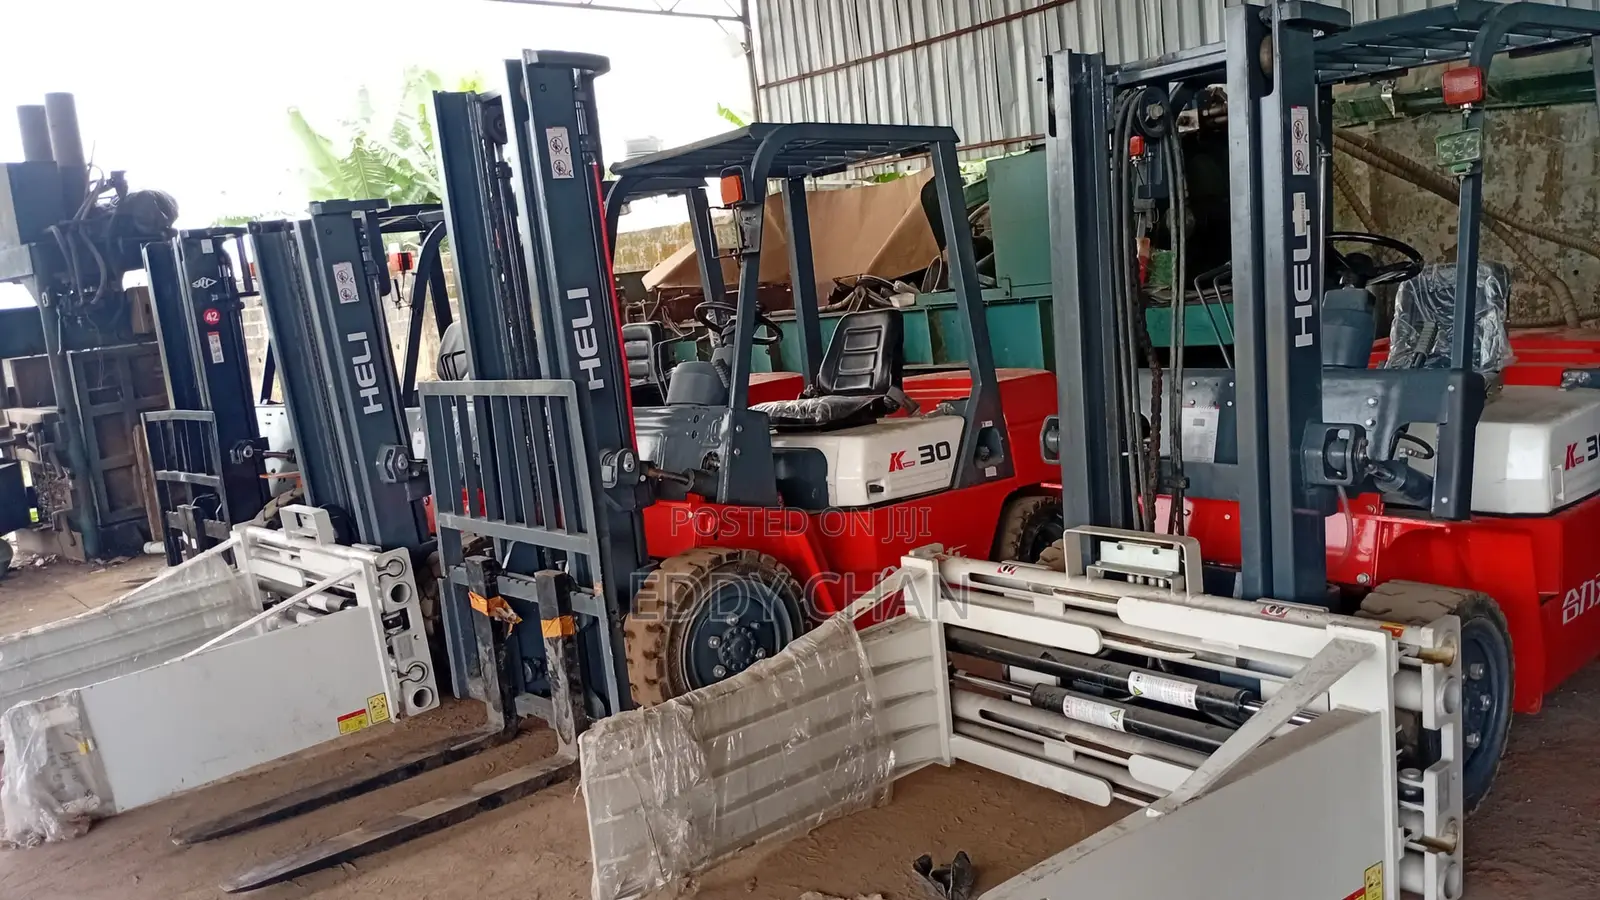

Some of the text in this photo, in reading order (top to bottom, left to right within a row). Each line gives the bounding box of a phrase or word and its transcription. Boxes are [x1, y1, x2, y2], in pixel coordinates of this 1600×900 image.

[206, 311, 219, 322] 42
[566, 287, 605, 390] HELI
[347, 331, 384, 414] HELI
[917, 440, 952, 465] 30
[1586, 432, 1600, 462] 3
